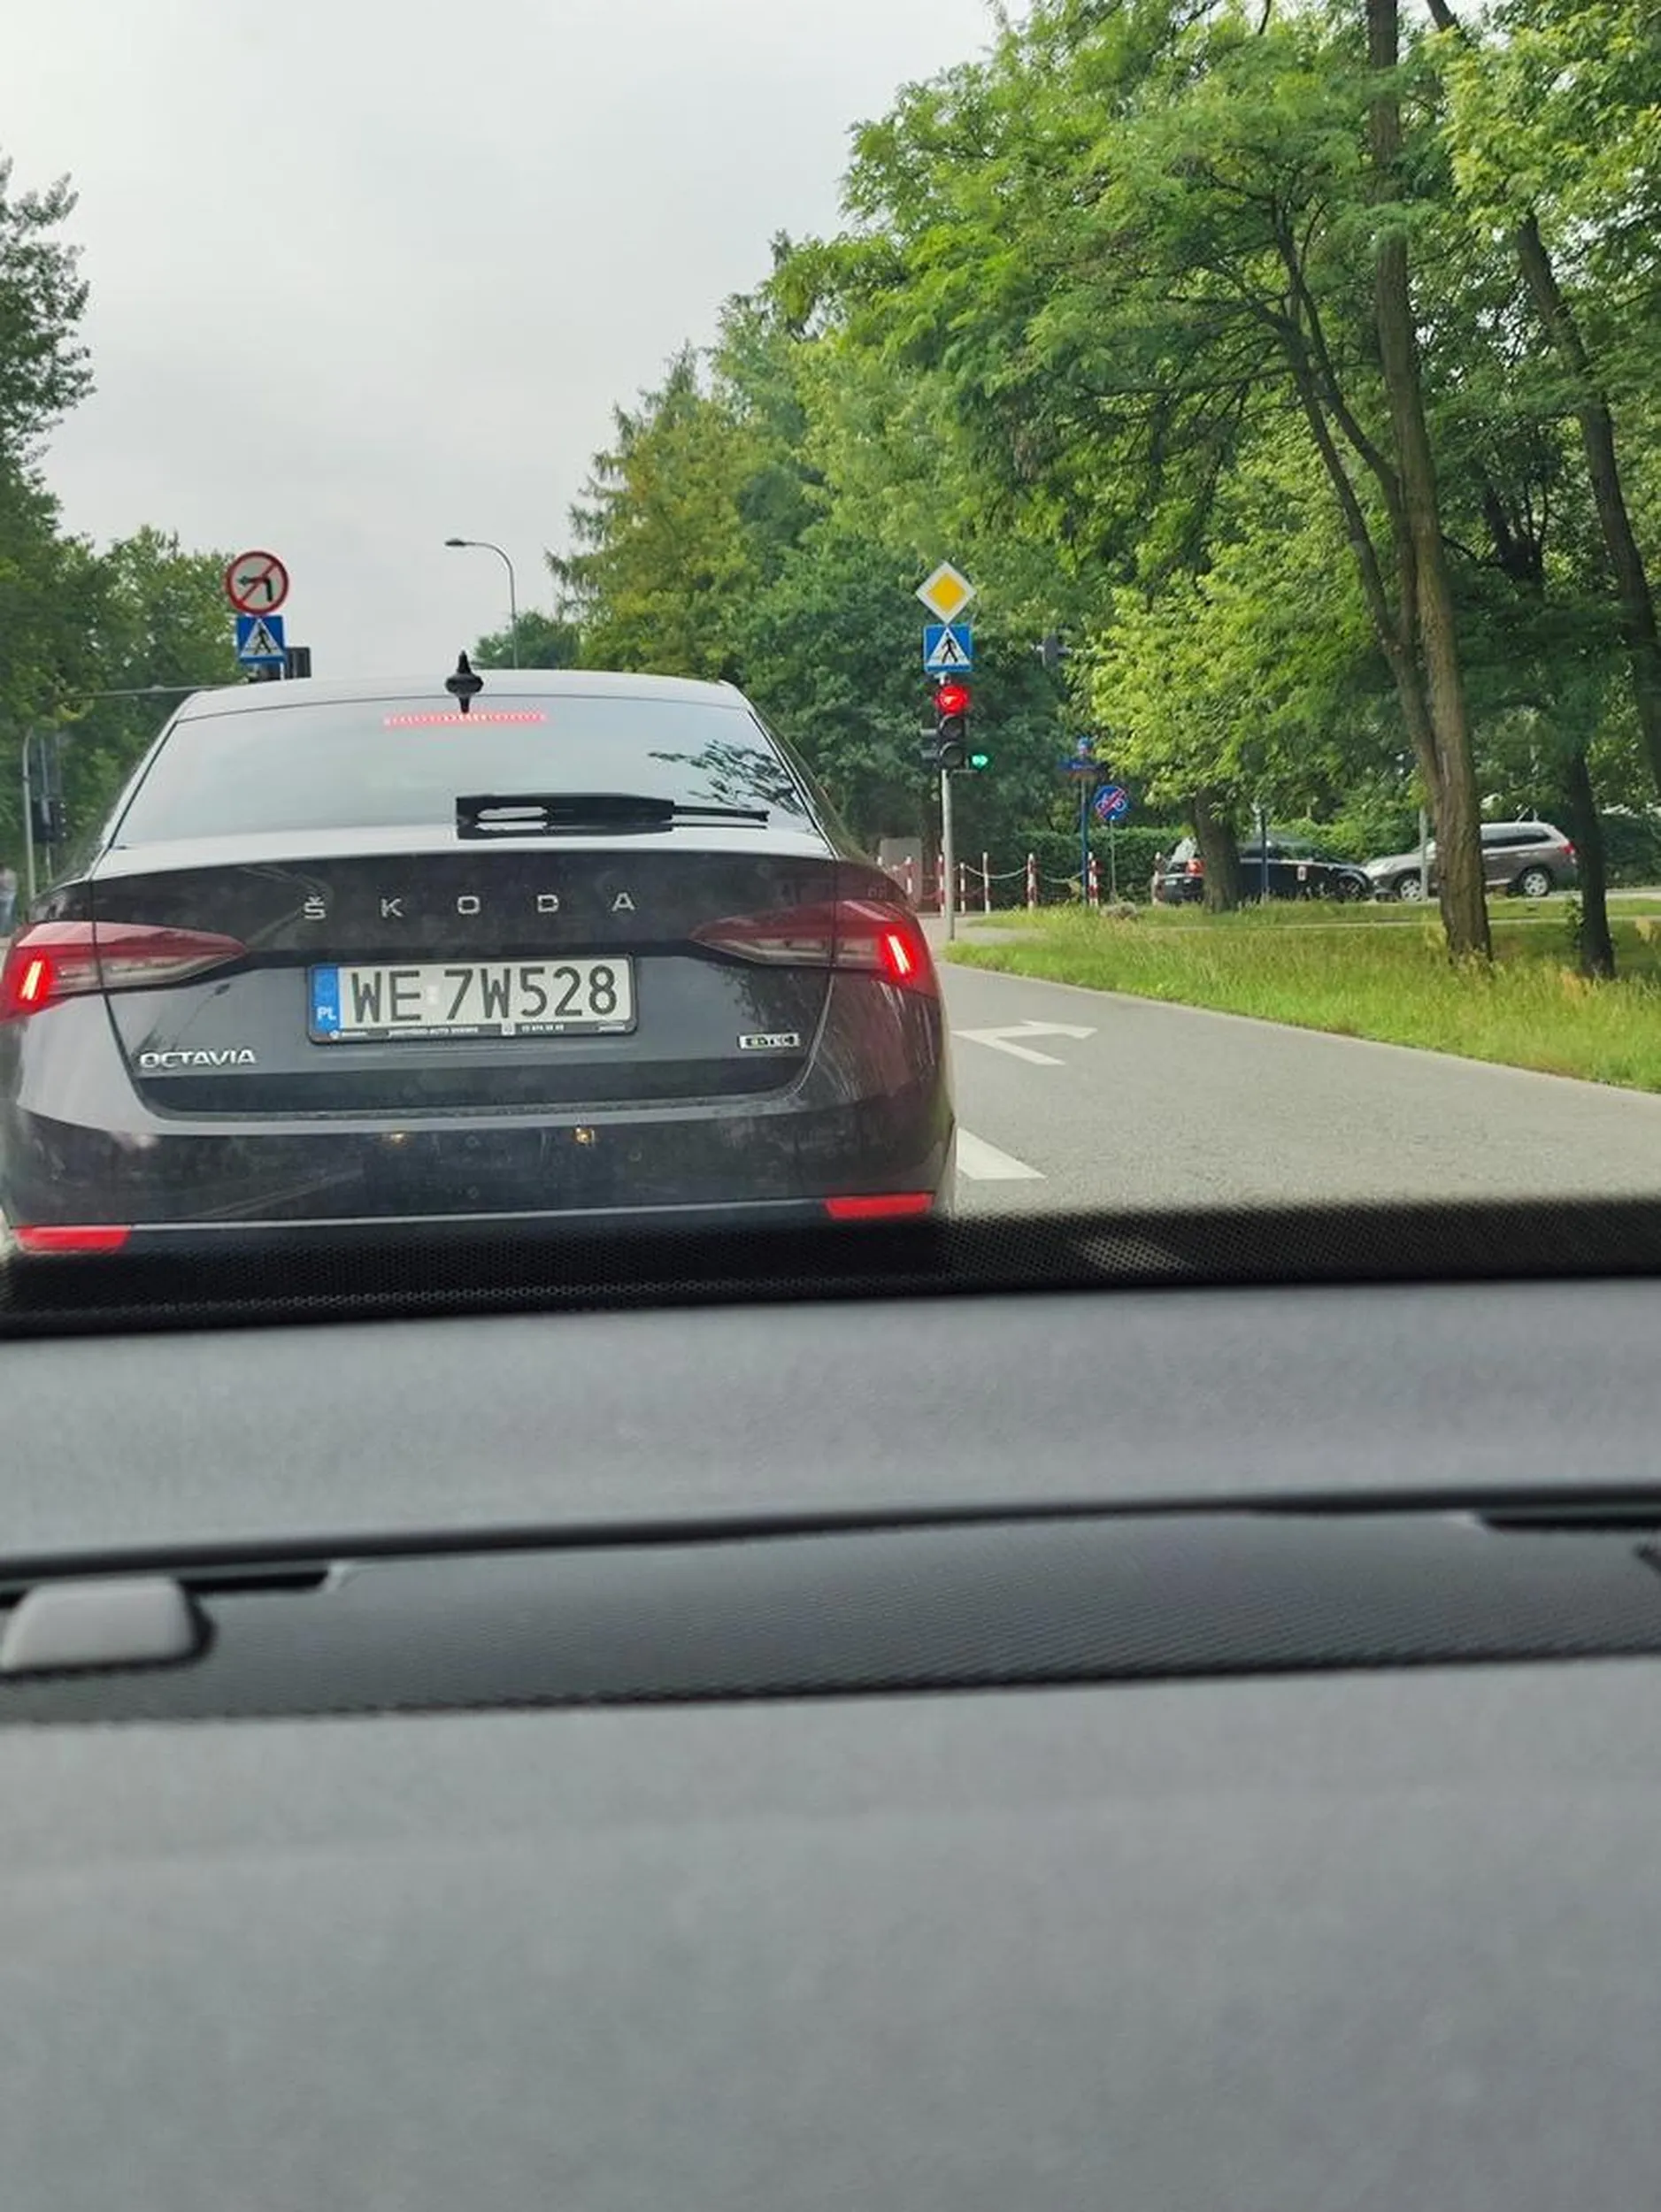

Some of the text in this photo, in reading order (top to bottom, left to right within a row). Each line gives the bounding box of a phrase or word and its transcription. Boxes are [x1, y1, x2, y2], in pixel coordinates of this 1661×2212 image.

[303, 892, 636, 920] ŠKODA
[351, 965, 618, 1024] WE 7W528
[316, 1005, 337, 1021] PL
[139, 1048, 257, 1069] OCTAVIA
